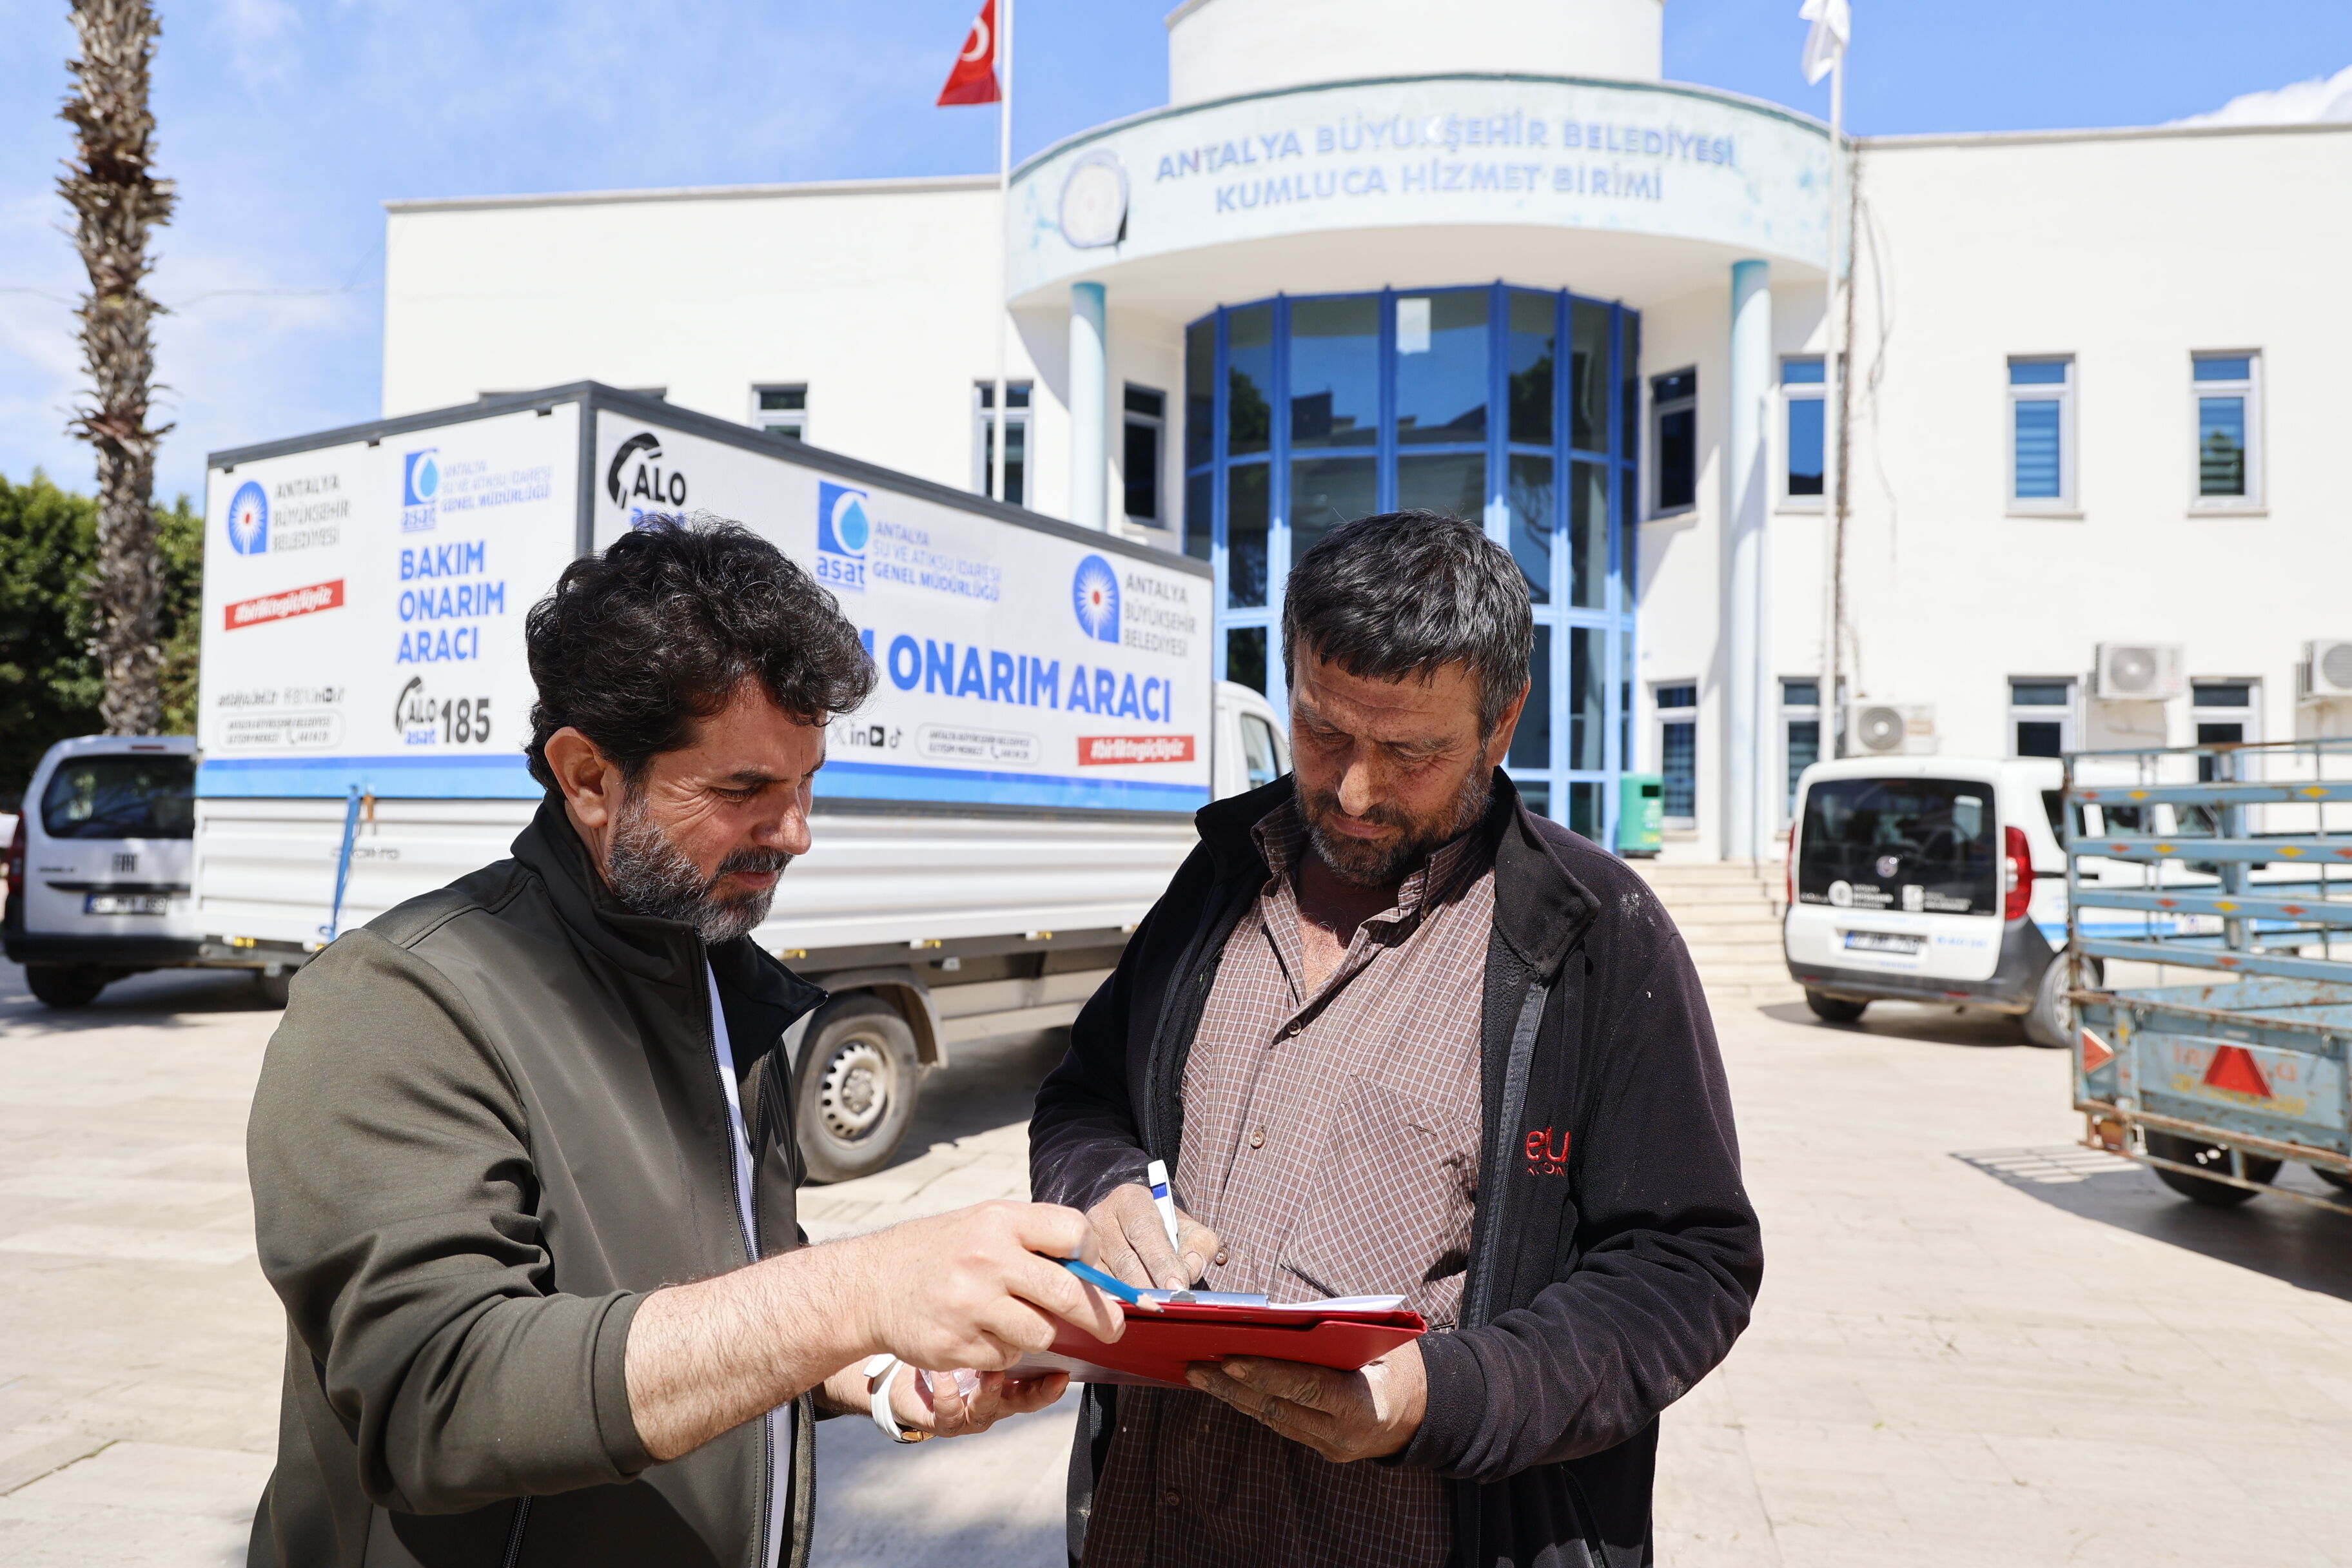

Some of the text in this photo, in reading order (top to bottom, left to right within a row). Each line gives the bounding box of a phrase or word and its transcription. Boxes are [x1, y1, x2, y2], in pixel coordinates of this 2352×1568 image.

[1155, 131, 1303, 181] ANTALYA
[1563, 121, 1734, 166] BELEDİYESİ
[1217, 166, 1387, 212] KUMLUCA
[1402, 158, 1541, 191] HİZMET
[634, 464, 686, 506] ALO
[875, 522, 930, 546] ANTALYA
[400, 540, 484, 580] BAKIM
[817, 556, 864, 584] asat
[872, 562, 916, 585] GENEL
[400, 581, 504, 622] ONARIM
[1125, 573, 1188, 604] ANTALYA
[397, 627, 477, 663] ARACI
[888, 634, 1059, 709] ONARIM
[1066, 665, 1171, 723] ARACI
[407, 698, 490, 743] ALO 185
